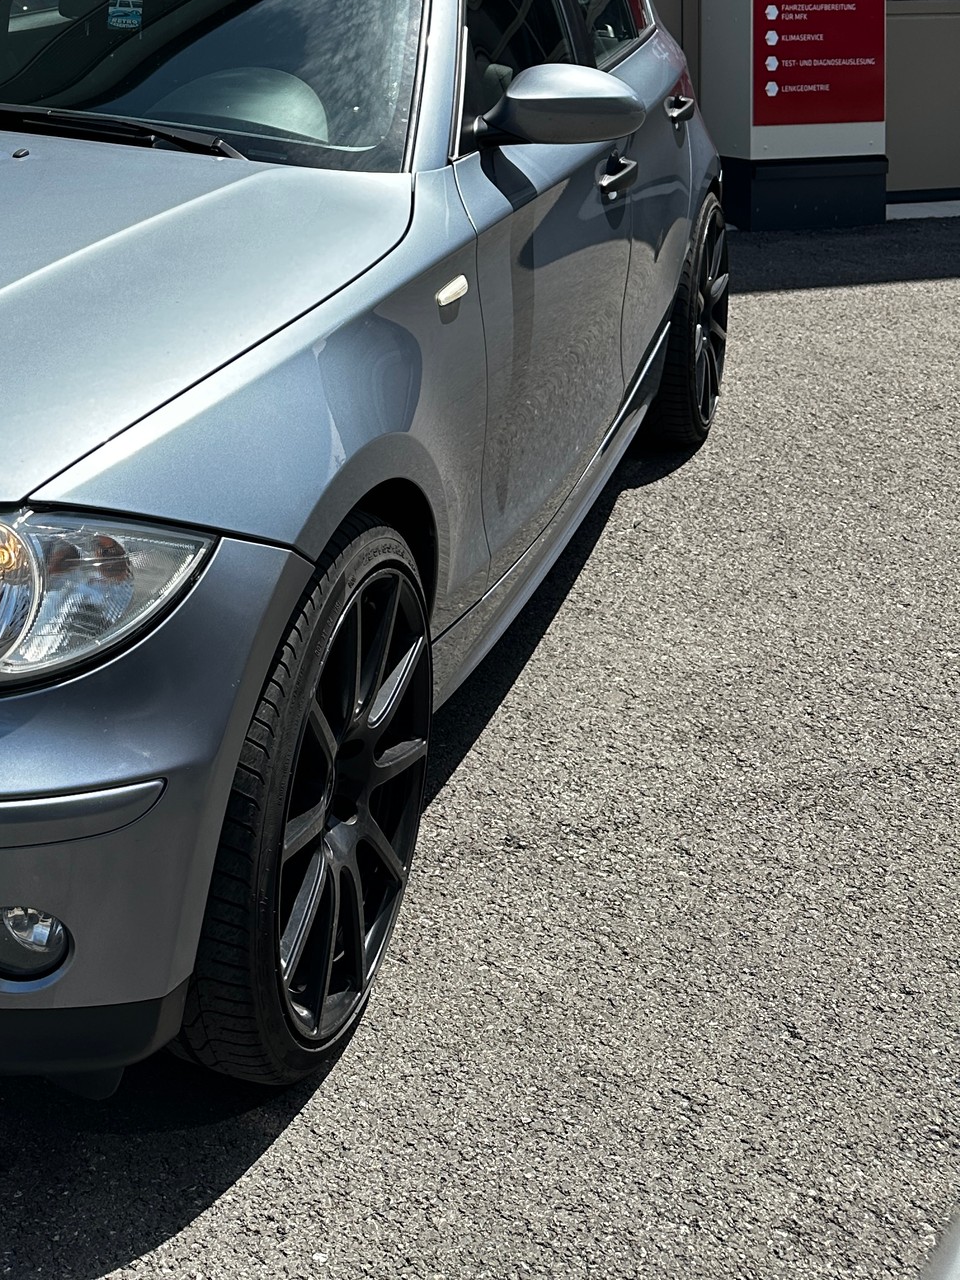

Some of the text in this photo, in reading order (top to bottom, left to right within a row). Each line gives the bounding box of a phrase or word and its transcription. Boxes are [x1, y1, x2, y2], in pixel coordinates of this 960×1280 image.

[781, 3, 856, 11] FAHRZEUGAUFBEREITUNG
[781, 58, 875, 67] TEST- UND DIAGNOSEAUSLESUNG
[781, 84, 830, 92] LENKGEOMETRIE
